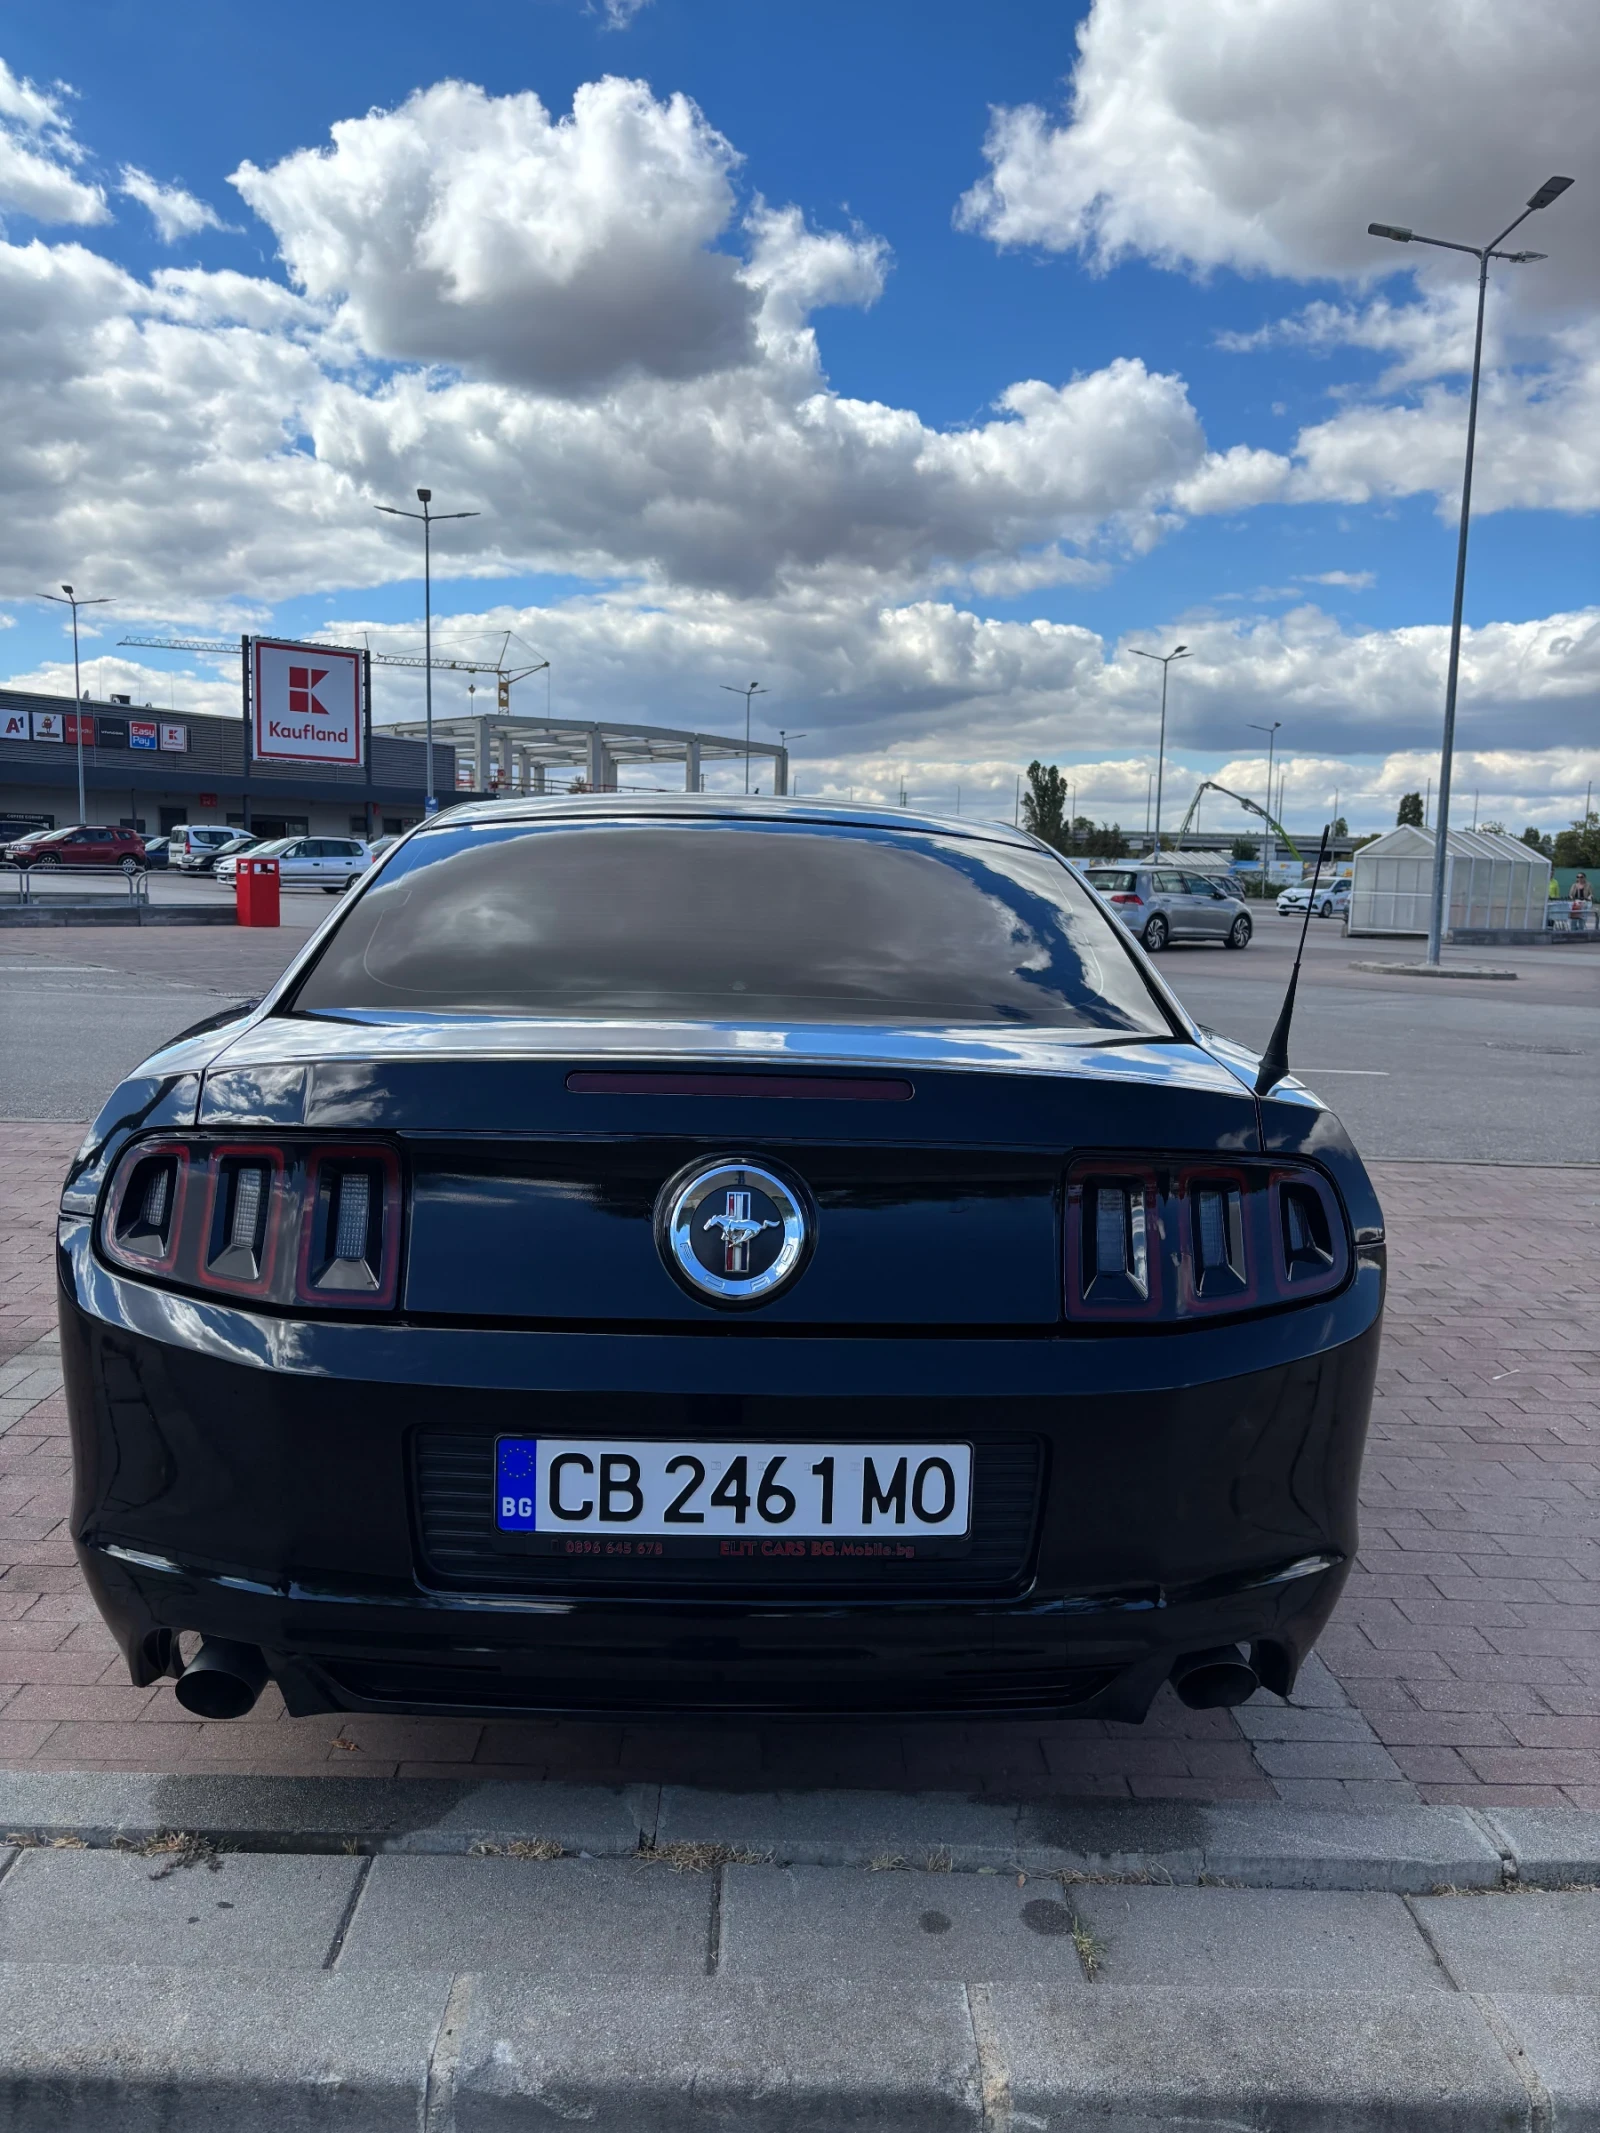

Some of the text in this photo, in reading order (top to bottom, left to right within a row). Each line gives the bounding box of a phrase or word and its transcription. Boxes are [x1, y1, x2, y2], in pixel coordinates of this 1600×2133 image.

[5, 716, 24, 733] A1
[132, 726, 155, 738] Easy
[269, 720, 348, 743] Kaufland
[132, 735, 150, 747] Pay
[549, 1452, 955, 1524] CB 2461 MO
[502, 1497, 532, 1517] BG
[565, 1540, 663, 1555] 0896 645 678
[761, 1540, 806, 1556] CARS
